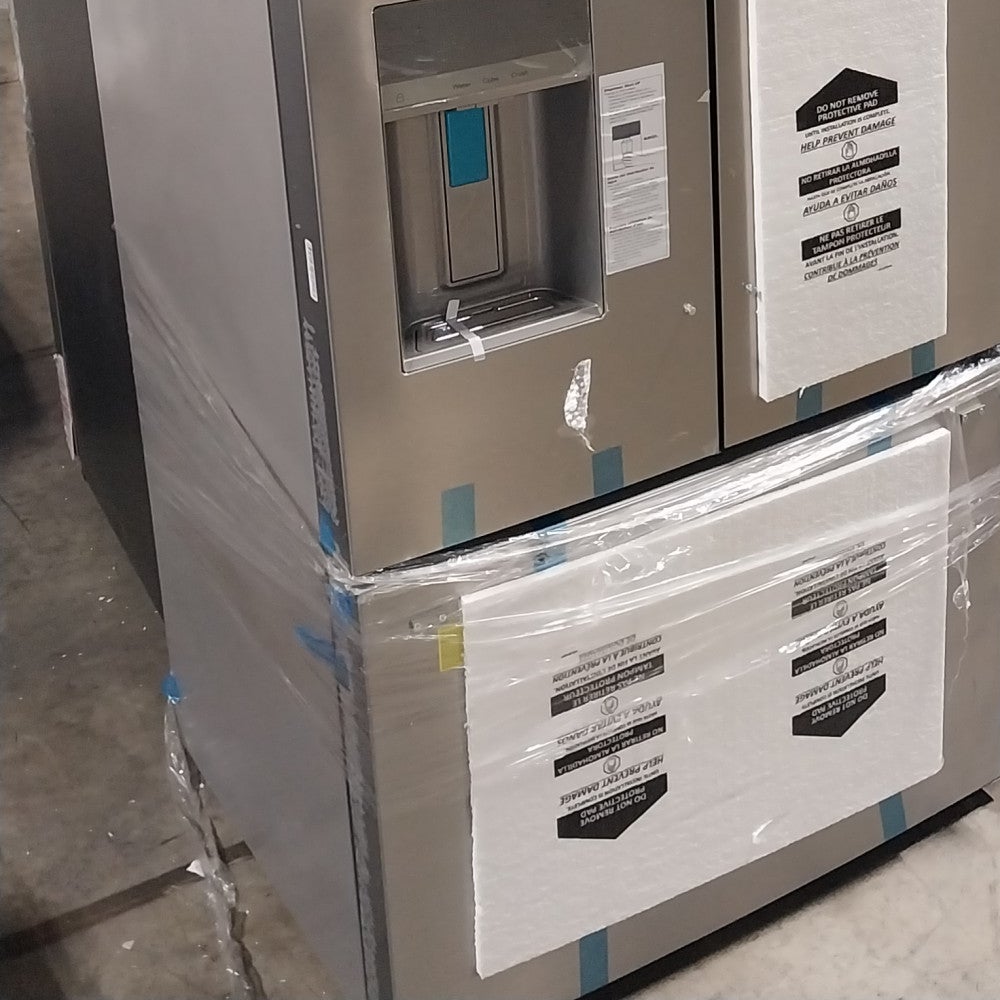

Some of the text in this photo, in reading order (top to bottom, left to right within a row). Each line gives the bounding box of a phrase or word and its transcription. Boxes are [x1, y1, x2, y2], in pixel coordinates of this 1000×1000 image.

[817, 89, 878, 113] DO NOT REMOVE
[819, 99, 878, 122] PROTECTIVE PAD
[802, 116, 896, 152] HELP PREVENT DAMAGE
[802, 149, 897, 185] NO RETIRAR LA ALMOHADILLA
[830, 166, 871, 185] PROTECTORA
[804, 199, 830, 215] AYUDA
[833, 196, 838, 205] A
[841, 187, 867, 203] EVITAR
[870, 177, 896, 193] DAÑOS
[813, 222, 891, 254] TAMPON PROTECTEUR
[820, 215, 883, 243] NE PAS RETIRER LE
[588, 729, 633, 753] PROTECTORA
[561, 755, 663, 806] HELP PREVENT DAMAGE
[581, 785, 645, 819] PROTECTIVE PAD
[581, 793, 646, 827] DO NOT REMOVE
